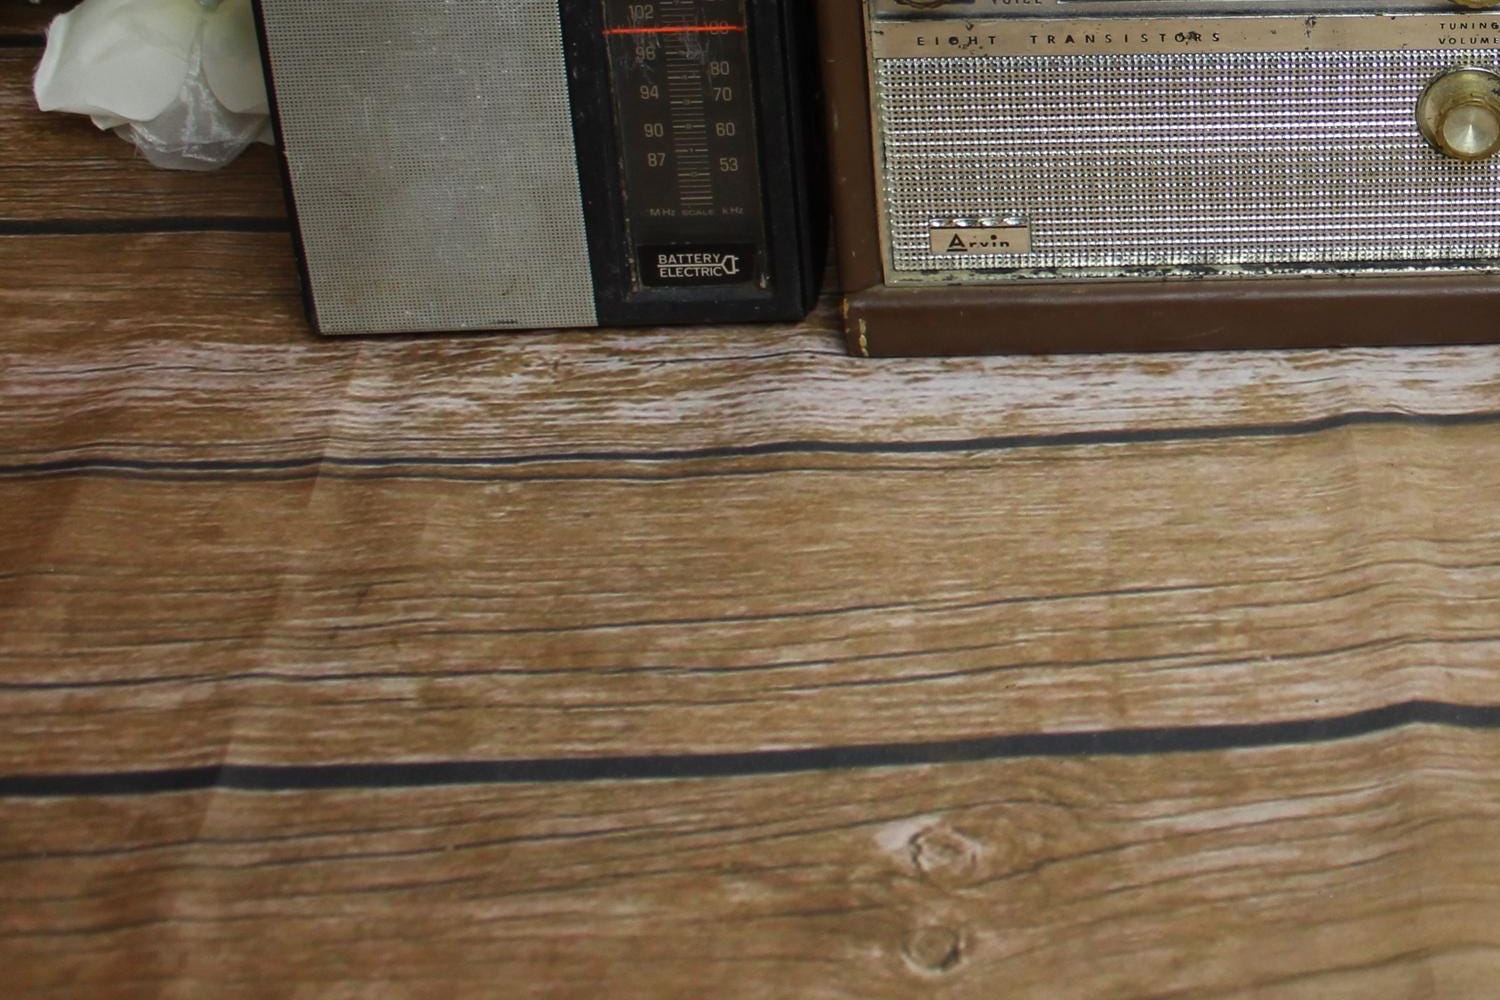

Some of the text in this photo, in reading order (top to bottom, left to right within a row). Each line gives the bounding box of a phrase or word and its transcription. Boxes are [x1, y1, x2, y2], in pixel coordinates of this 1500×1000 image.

[628, 4, 654, 20] 102
[1440, 22, 1500, 30] TUNING
[917, 32, 1220, 47] EIGHT TRANSISTORS
[1438, 36, 1500, 46] VOLUME
[710, 60, 730, 76] 80
[639, 85, 659, 100] 94
[712, 87, 732, 102] 70
[643, 123, 664, 138] 90
[715, 122, 736, 137] 60
[647, 152, 666, 168] 87
[719, 157, 738, 172] 53
[947, 233, 1010, 251] Arvin
[658, 252, 721, 264] BATTERY
[660, 266, 723, 279] ELECTRIC
